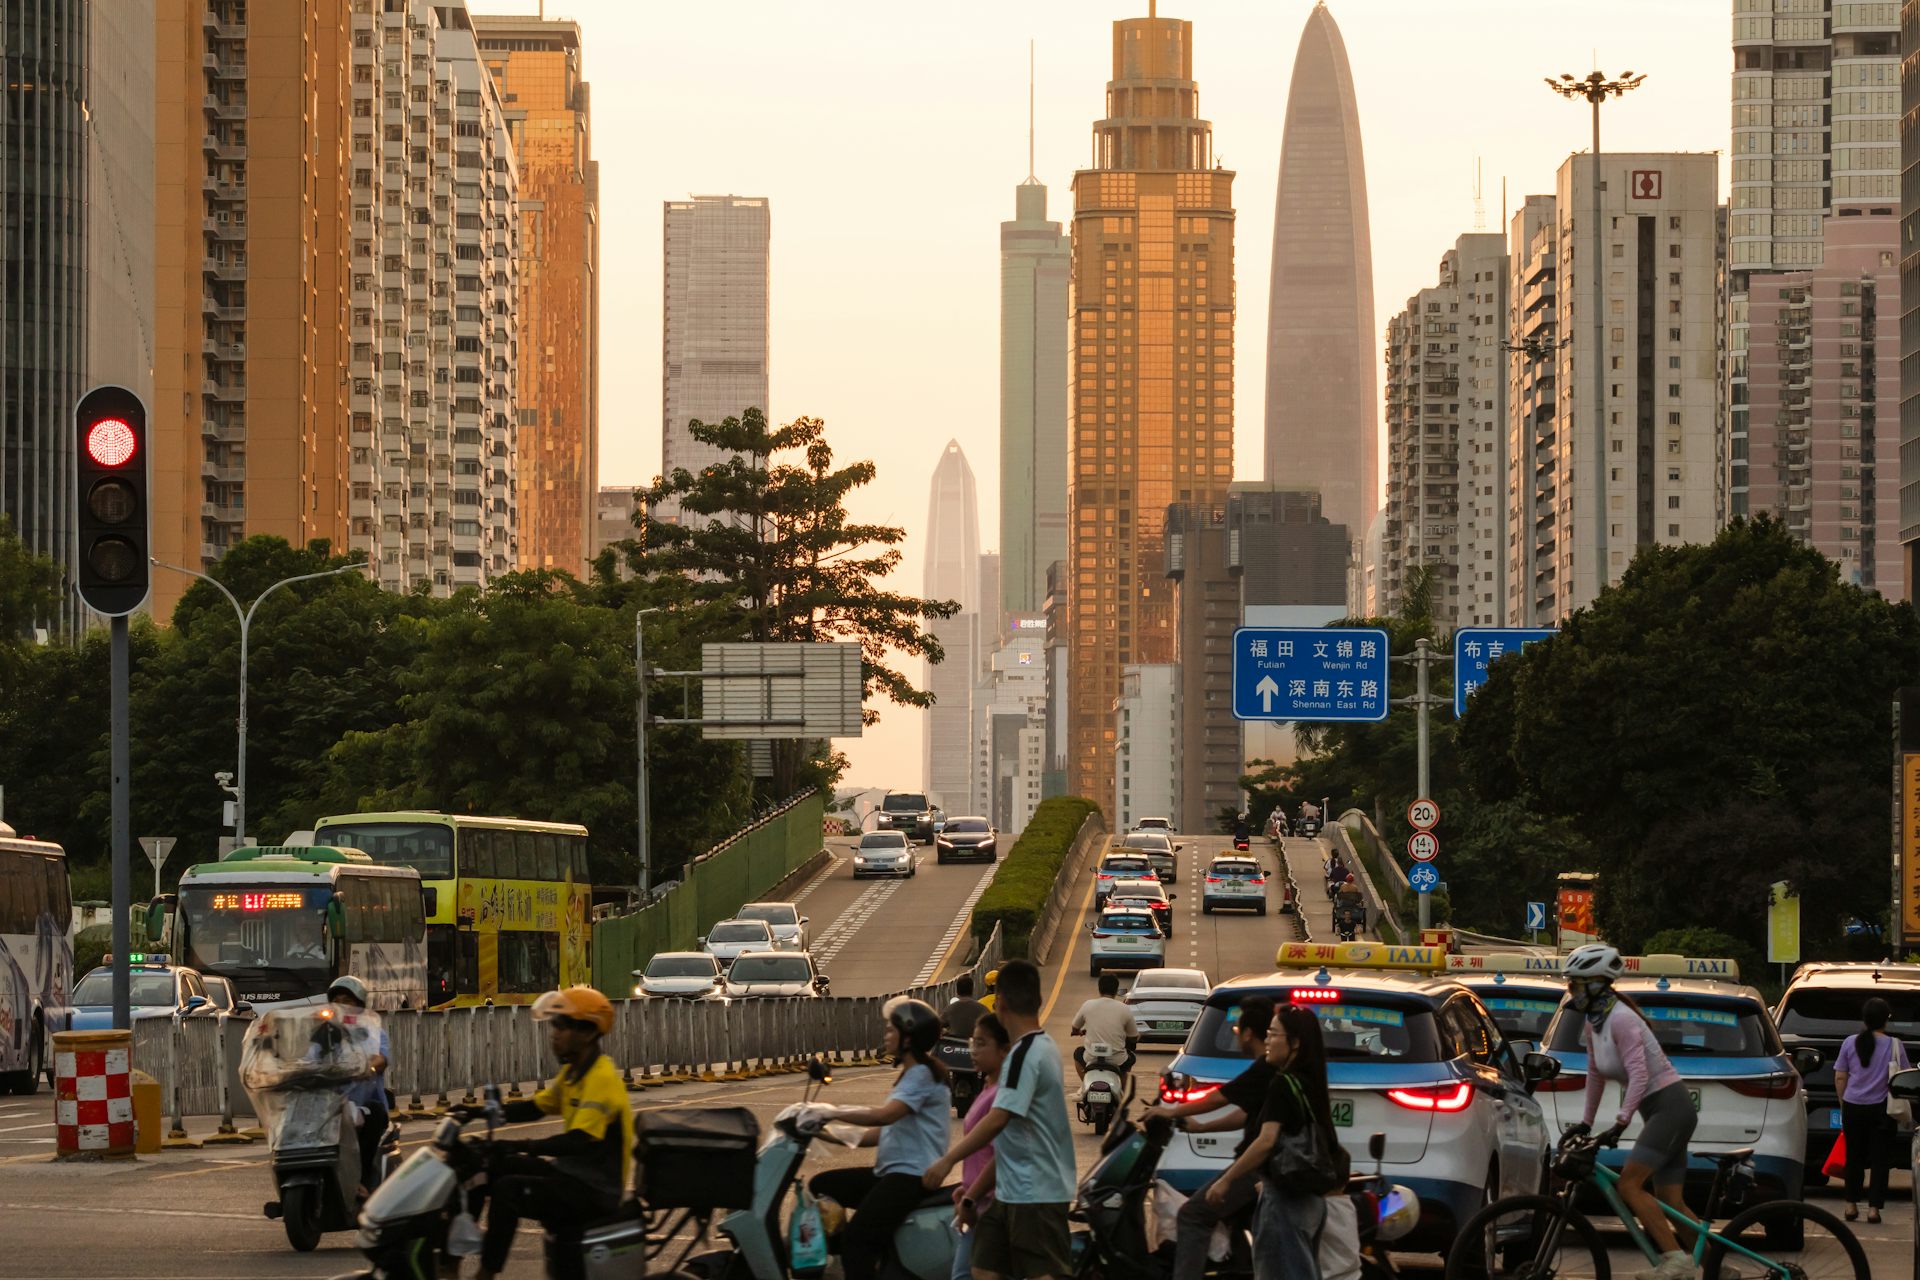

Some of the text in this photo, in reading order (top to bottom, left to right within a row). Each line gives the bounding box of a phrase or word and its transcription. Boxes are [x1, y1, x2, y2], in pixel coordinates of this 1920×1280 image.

[1249, 639, 1294, 658] 福田
[1313, 640, 1377, 659] 文锦路
[1464, 640, 1504, 659] 布吉
[1257, 660, 1286, 669] Futian
[1322, 661, 1368, 671] Wenjin Rd
[1288, 679, 1378, 699] 深南东路
[1292, 700, 1376, 709] Shennan East Rd
[1287, 944, 1335, 960] 深圳
[1388, 947, 1432, 963] TAXI
[1450, 956, 1483, 968] 深圳
[1523, 958, 1560, 970] TAXI
[1687, 959, 1728, 974] TAXI
